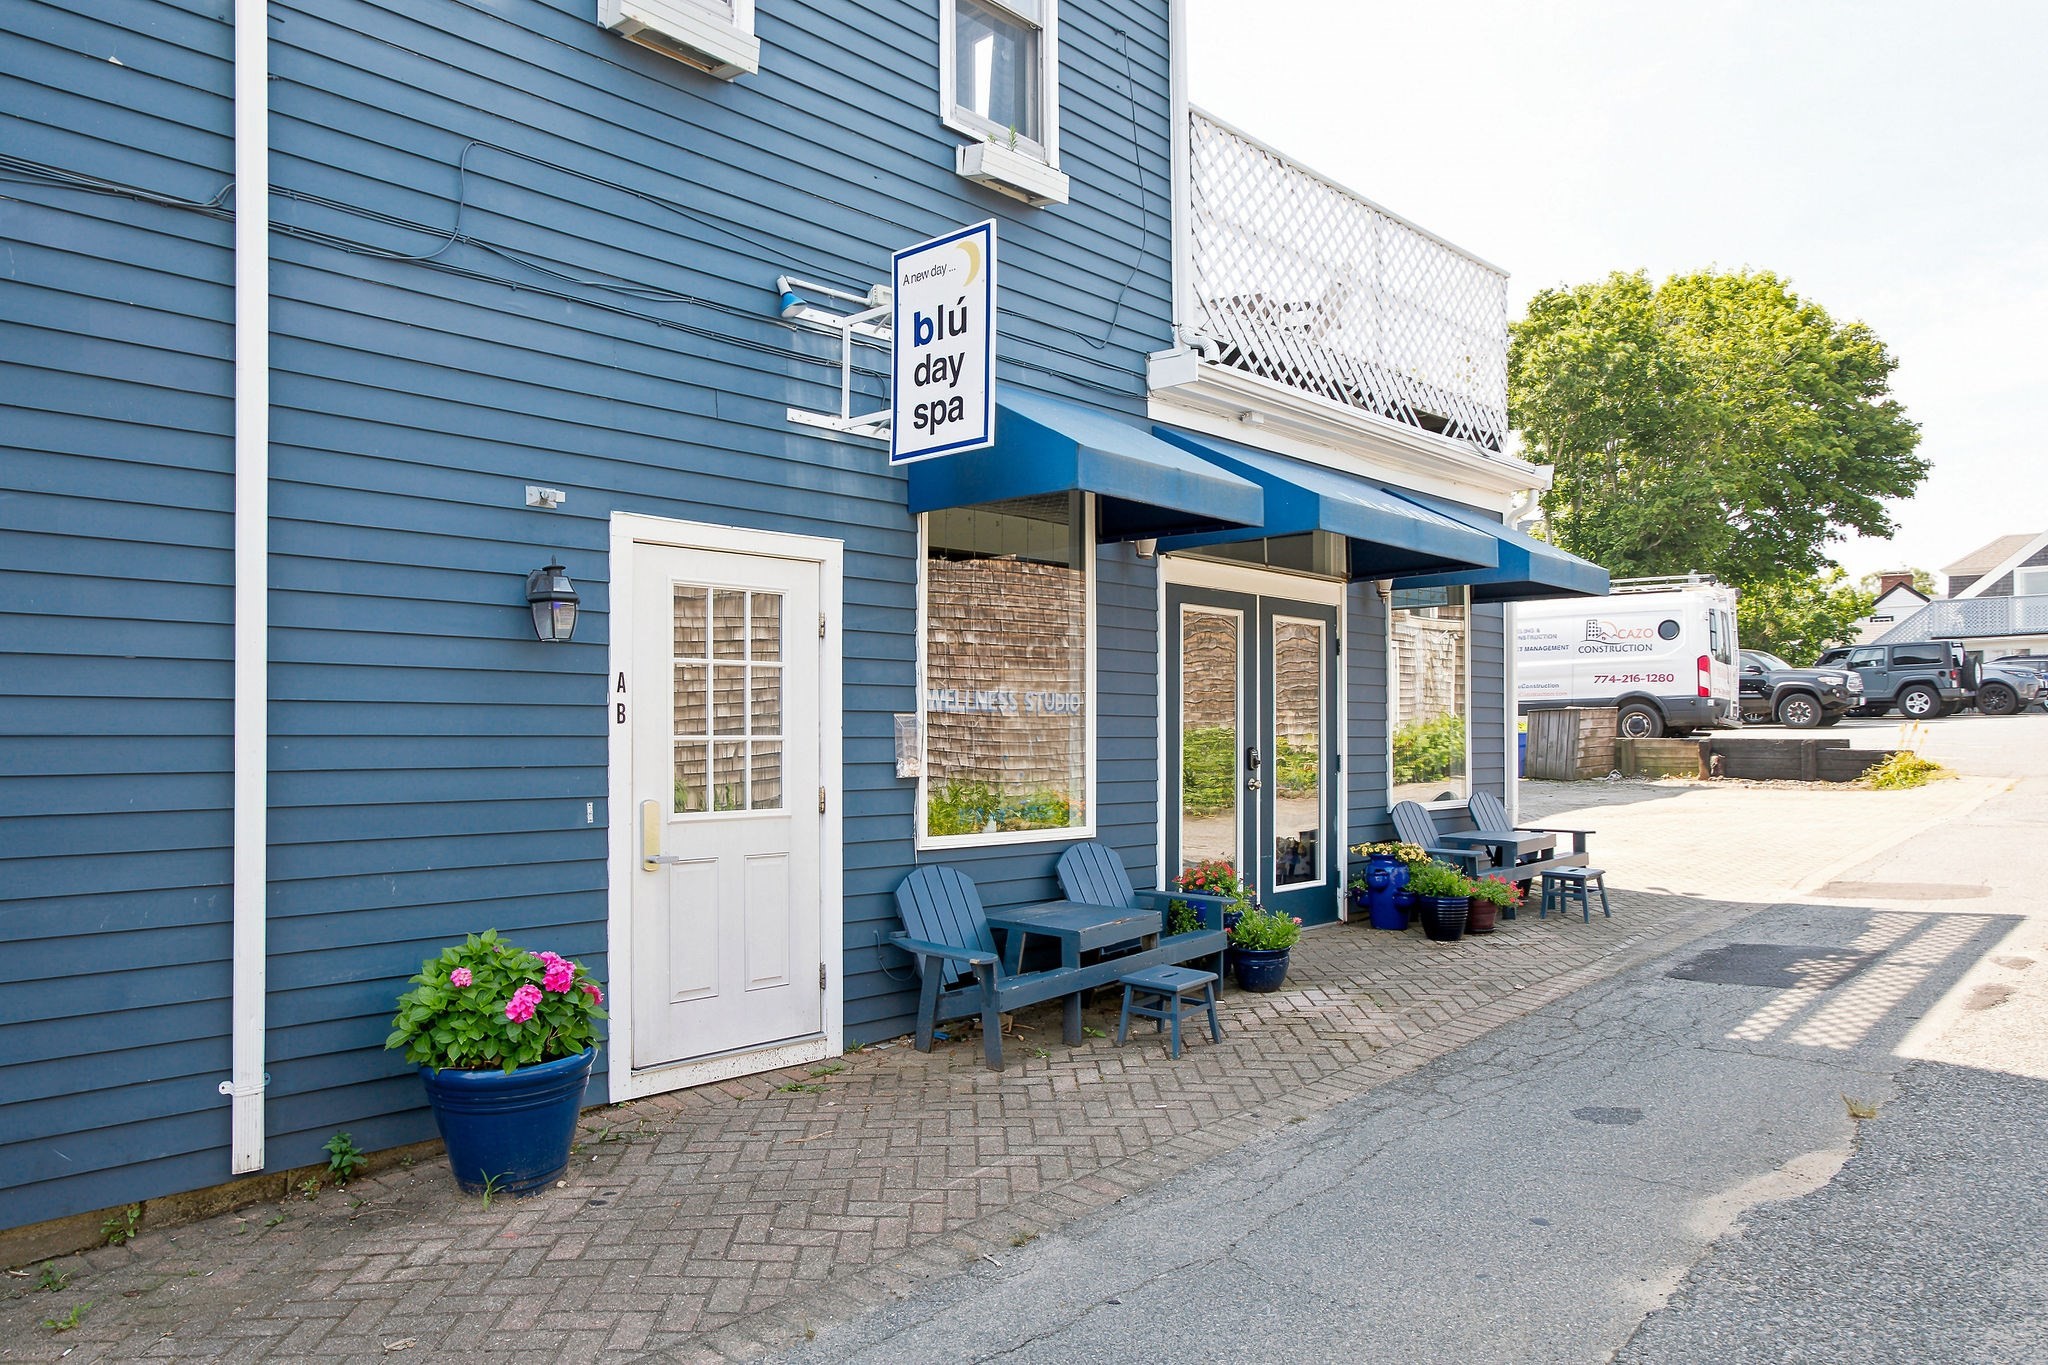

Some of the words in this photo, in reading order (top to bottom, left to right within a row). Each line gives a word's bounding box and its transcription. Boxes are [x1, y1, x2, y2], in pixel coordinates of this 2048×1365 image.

[903, 274, 910, 286] A
[911, 270, 929, 283] new
[931, 264, 947, 277] day
[913, 296, 967, 347] blú
[914, 352, 965, 388] day
[913, 395, 964, 435] spa
[1618, 628, 1653, 639] CAZO
[1578, 644, 1653, 654] CONSTRUCTION
[617, 672, 626, 693] A
[1594, 673, 1675, 684] 774-216-1280
[927, 689, 1018, 713] WELLNESS
[1024, 691, 1081, 714] STUDIO
[617, 703, 626, 724] B
